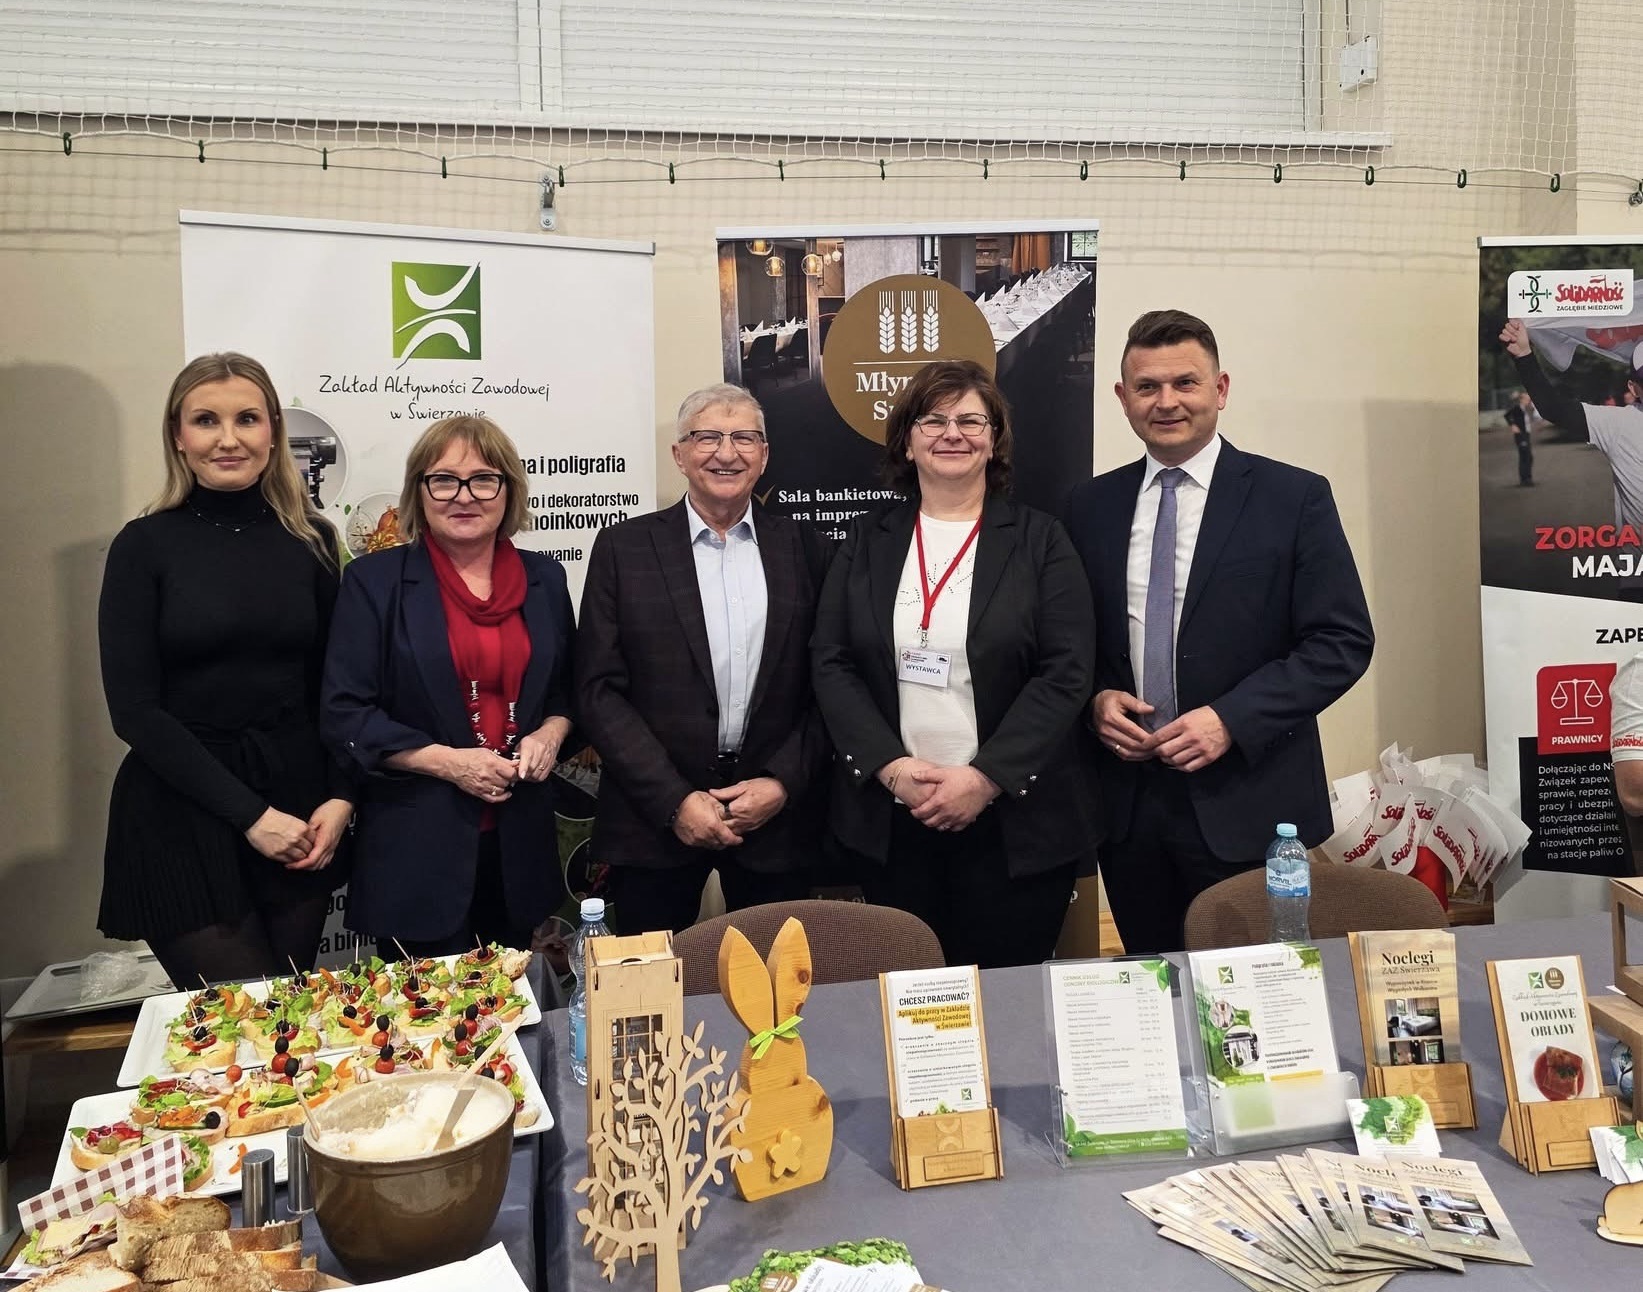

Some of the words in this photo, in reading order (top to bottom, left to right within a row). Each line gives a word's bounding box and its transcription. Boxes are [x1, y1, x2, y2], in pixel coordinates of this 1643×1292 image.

[319, 374, 378, 393] Zakład
[384, 375, 467, 401] Aktywności
[472, 376, 550, 401] Zawodowej
[390, 410, 402, 420] w
[548, 455, 626, 476] poligrafia
[548, 492, 639, 508] dekoratorstwo
[778, 489, 811, 503] Sala
[1535, 524, 1643, 550] ZORGA
[905, 663, 941, 675] WYSTAWCA
[1551, 734, 1604, 745] PRAWNICY
[1538, 763, 1587, 775] Dołączając
[1588, 763, 1601, 771] do
[1538, 776, 1577, 787] Związek
[1538, 788, 1577, 800] sprawie,
[1578, 788, 1611, 797] reprez
[1539, 802, 1565, 813] pracy
[1569, 800, 1573, 809] i
[1539, 812, 1583, 824] dotyczące
[1543, 823, 1602, 836] umiejętności
[1539, 836, 1595, 848] nizowanych
[1547, 851, 1559, 860] na
[1560, 848, 1588, 860] stacje
[1589, 847, 1614, 858] paliw
[1381, 950, 1434, 966] Noclegi
[899, 996, 926, 1006] CHCESZ
[927, 992, 970, 1003] PRACOWAĆ?
[1520, 1007, 1577, 1022] DOMOWE
[1530, 1023, 1575, 1037] OBIADY
